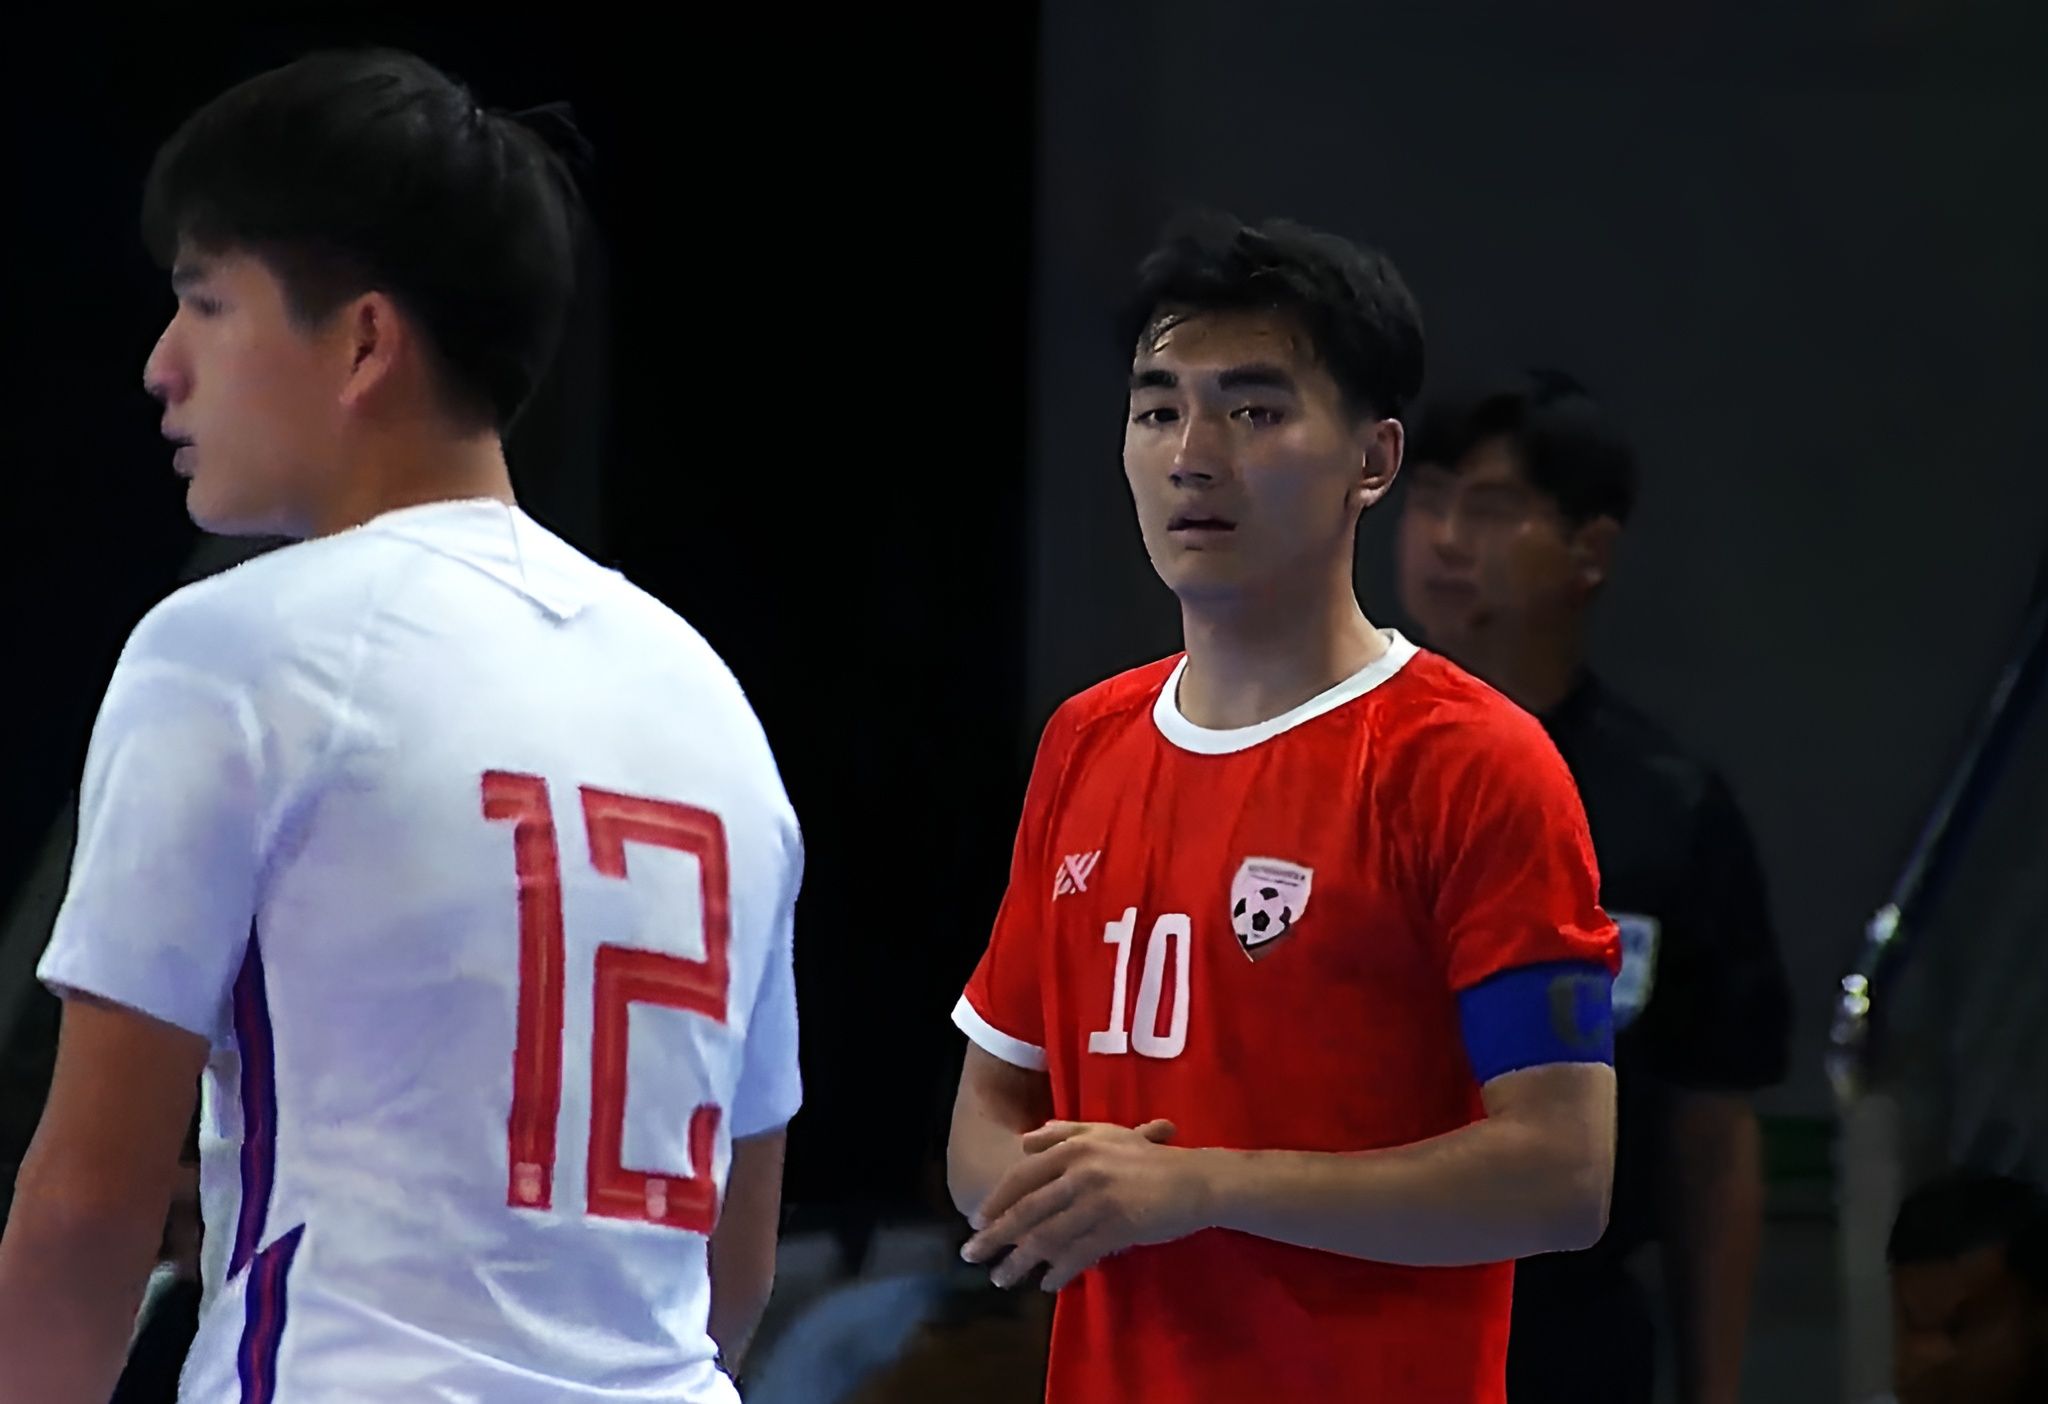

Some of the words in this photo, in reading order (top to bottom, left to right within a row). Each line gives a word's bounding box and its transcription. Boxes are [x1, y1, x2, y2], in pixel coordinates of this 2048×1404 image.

[481, 769, 730, 1235] 12
[1088, 907, 1191, 1058] 10
[1547, 973, 1612, 1050] C
